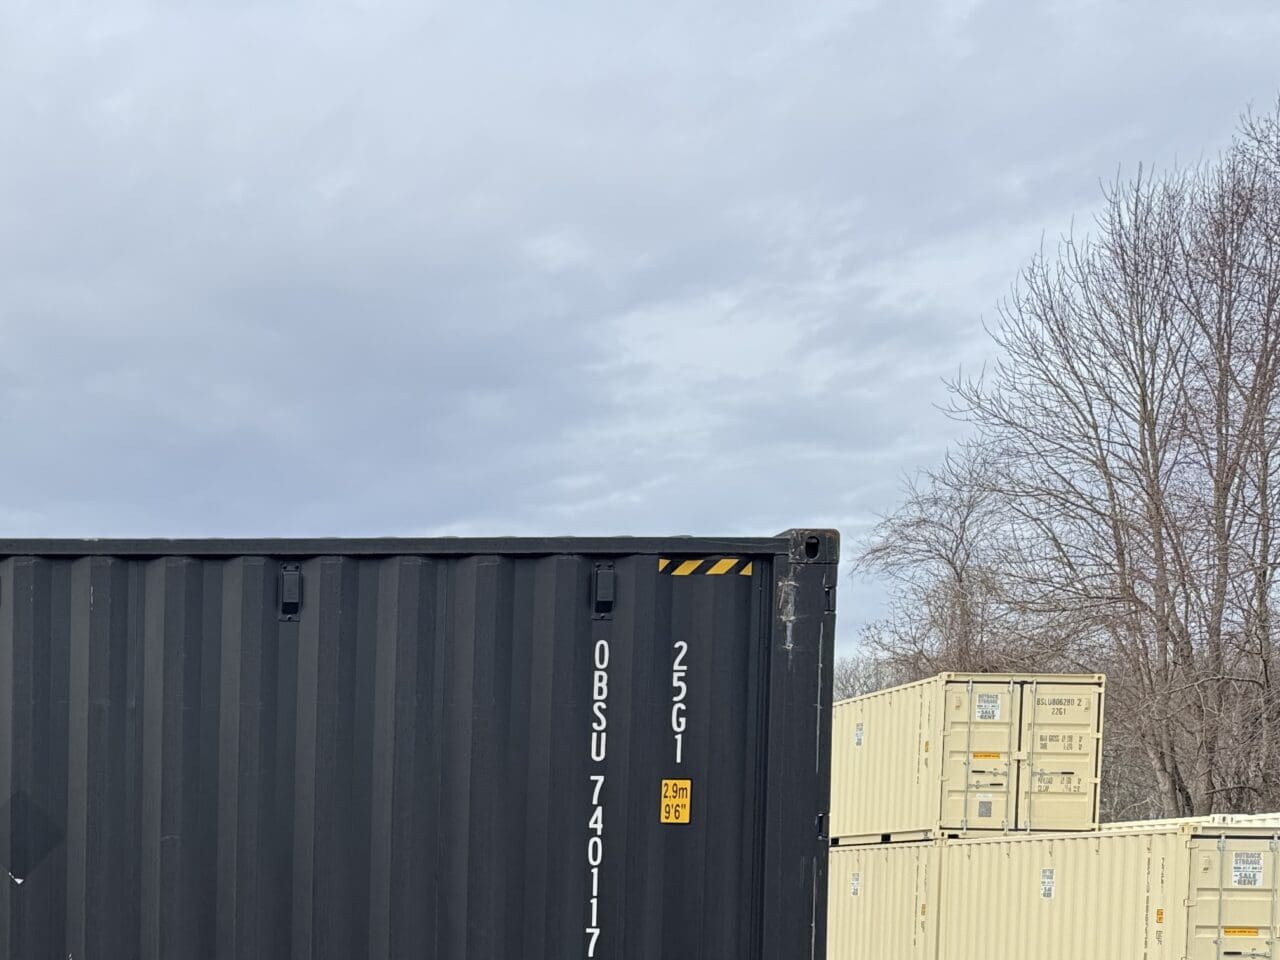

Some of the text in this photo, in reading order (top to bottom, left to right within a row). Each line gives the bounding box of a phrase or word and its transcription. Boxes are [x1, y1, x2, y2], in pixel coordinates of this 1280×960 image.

[590, 639, 610, 762] OBSU
[671, 640, 688, 764] 25G1
[663, 782, 688, 799] 2.9m
[585, 775, 605, 958] 740117
